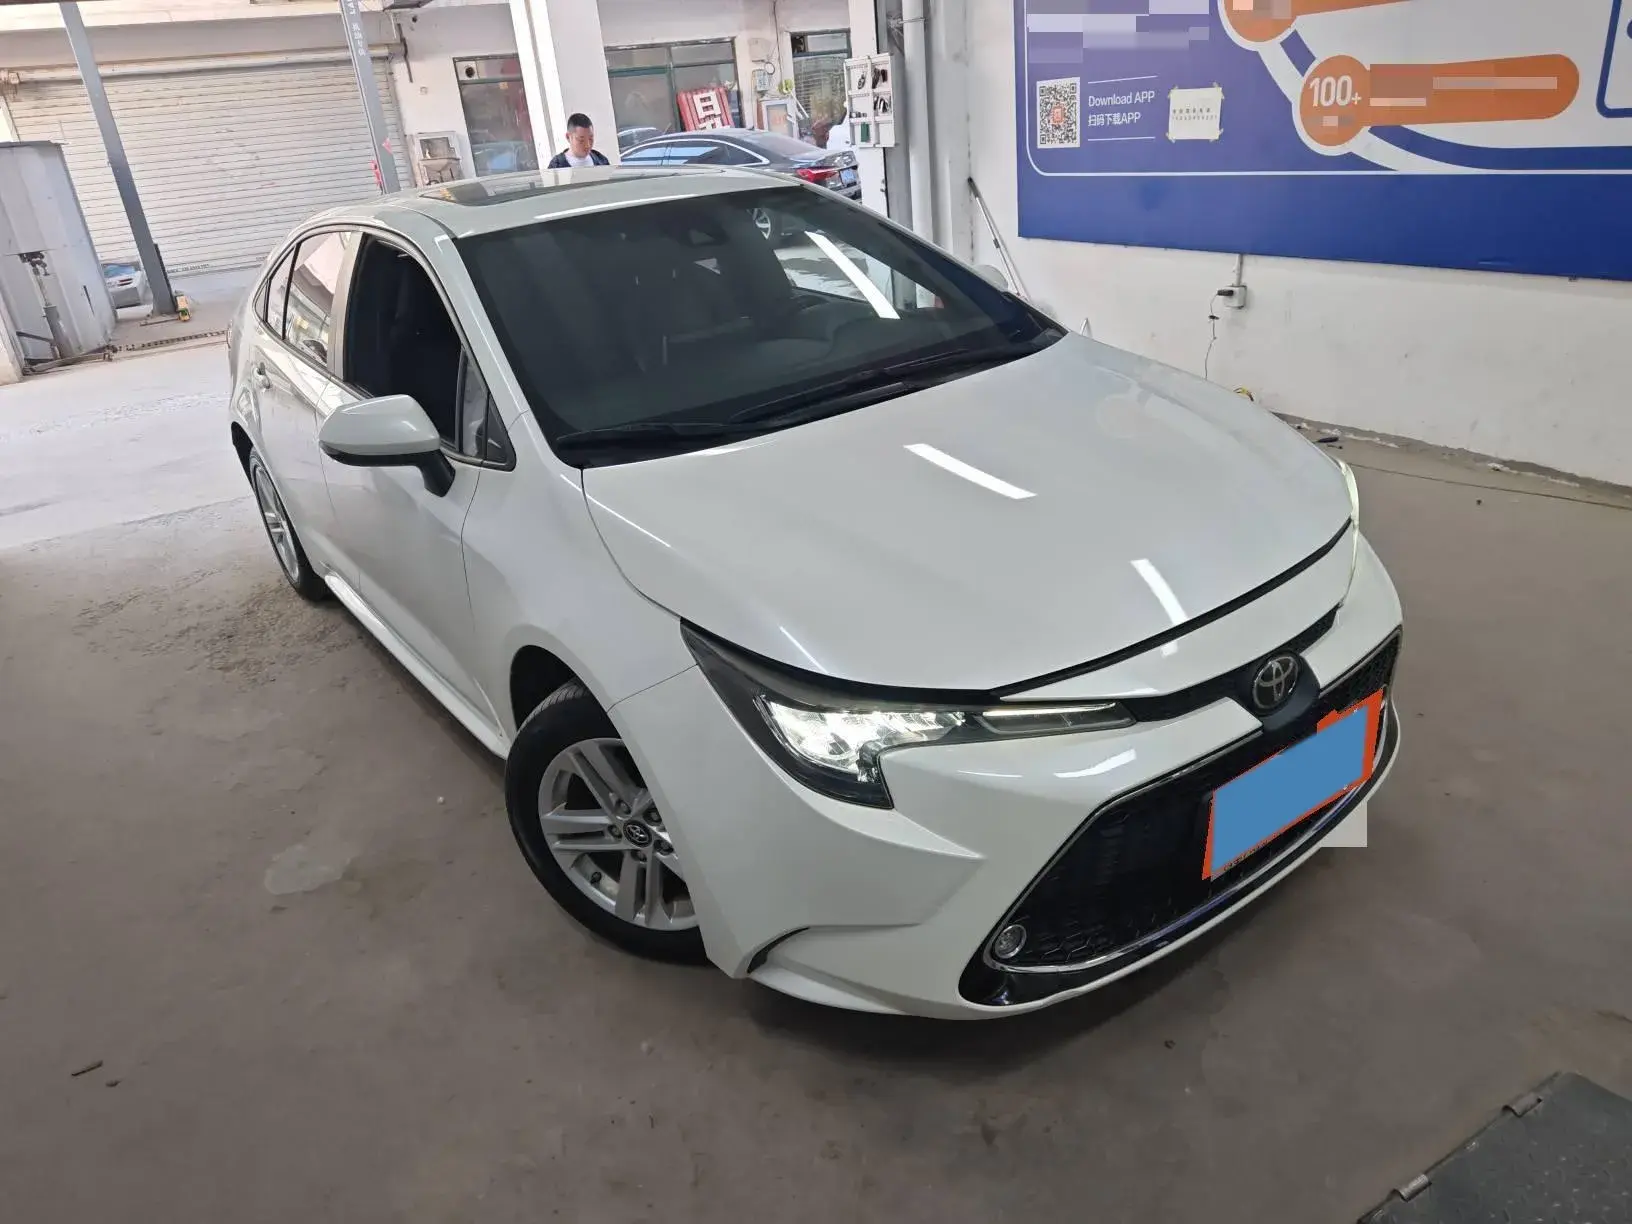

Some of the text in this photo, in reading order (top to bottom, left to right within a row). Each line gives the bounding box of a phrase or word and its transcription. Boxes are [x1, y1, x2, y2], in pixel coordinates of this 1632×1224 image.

[1088, 90, 1155, 107] Download APP
[1309, 75, 1362, 107] 100+
[1088, 111, 1142, 127] 扫码下载APP
